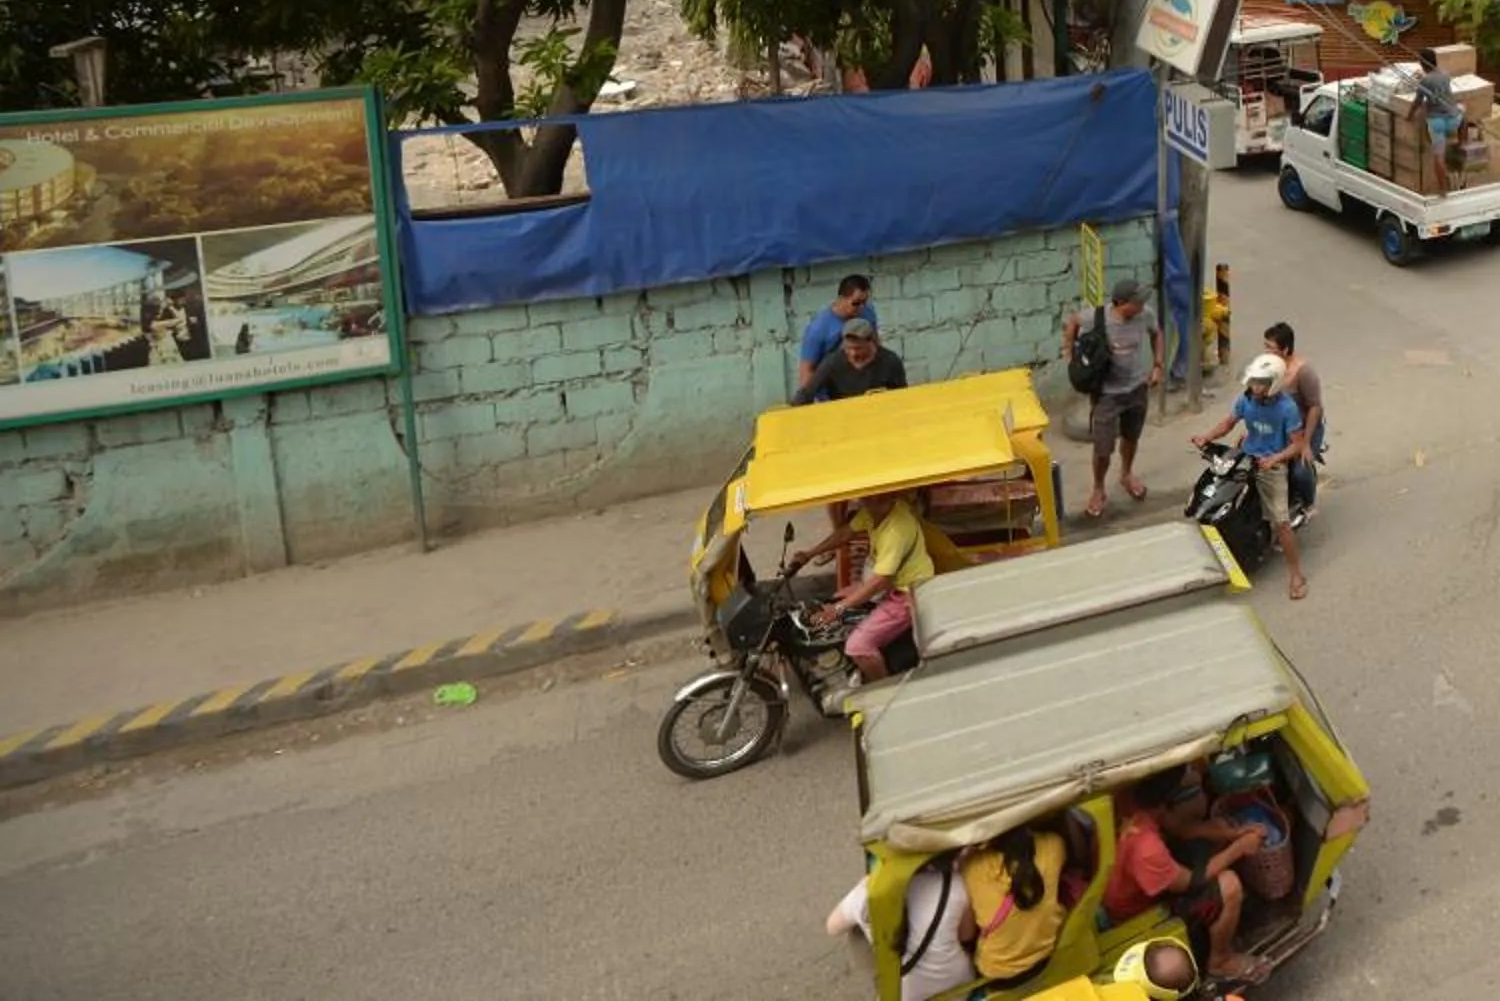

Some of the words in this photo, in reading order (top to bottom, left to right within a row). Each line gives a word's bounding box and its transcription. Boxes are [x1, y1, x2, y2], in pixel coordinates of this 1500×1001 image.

[26, 129, 80, 144] Hotel
[85, 128, 100, 141] &
[105, 118, 224, 139] Commercial
[1164, 89, 1207, 148] PULIS
